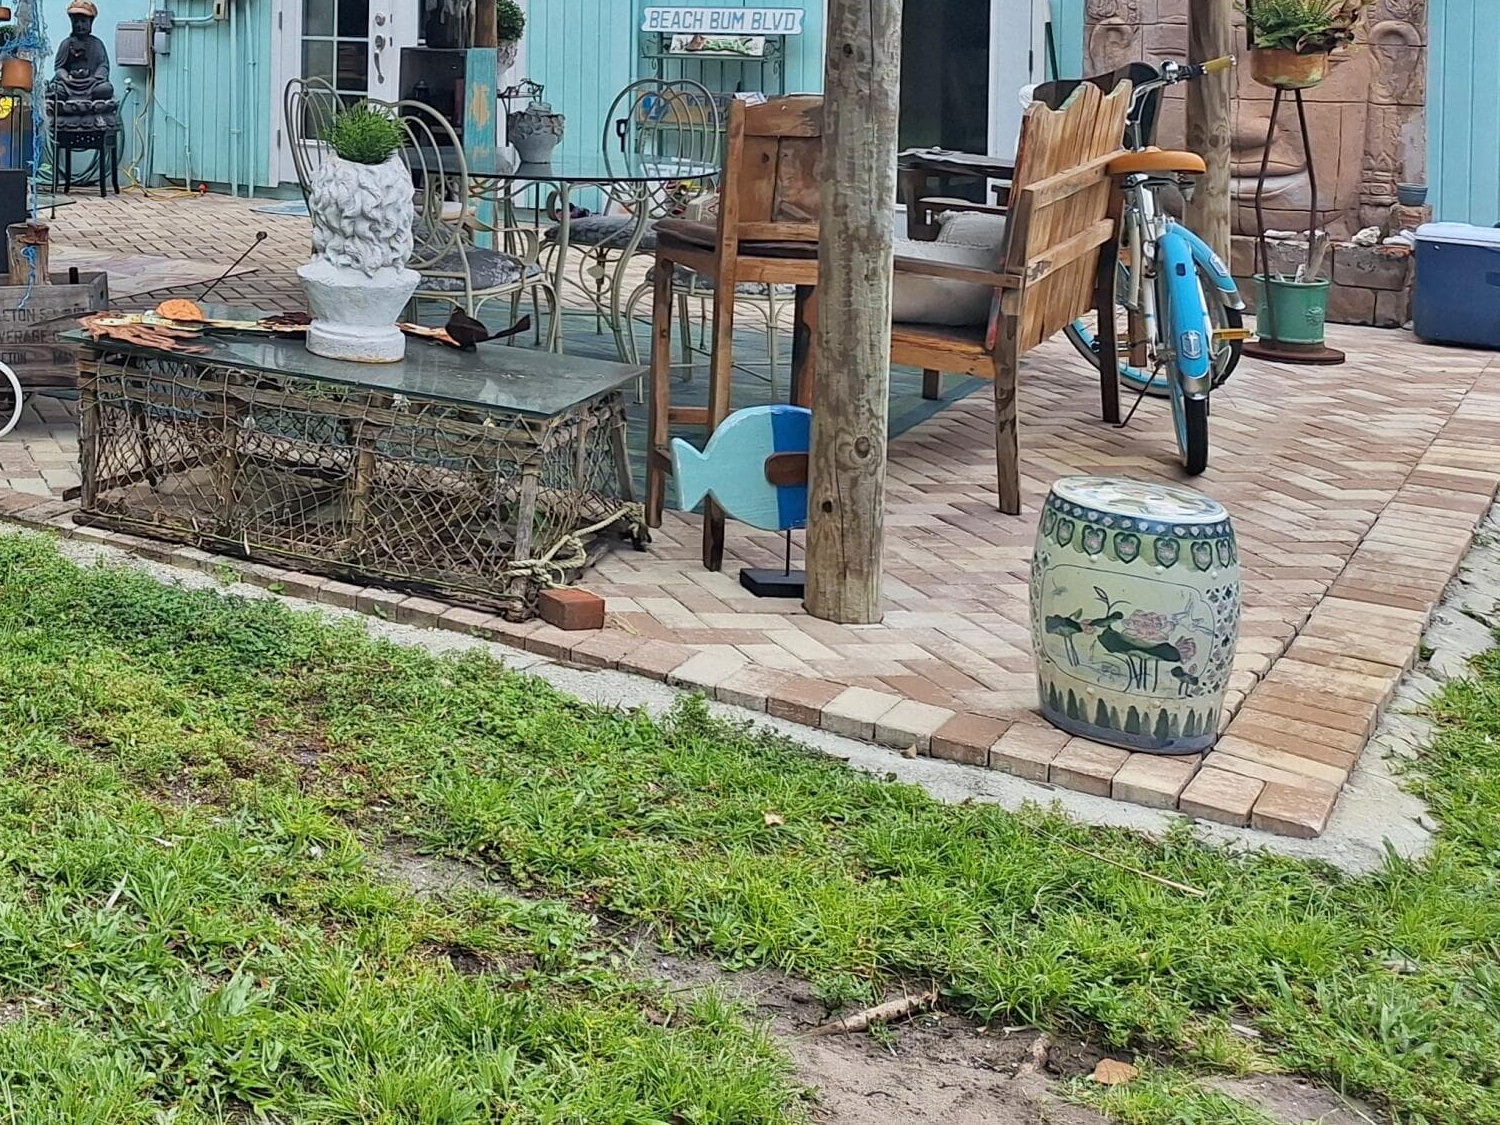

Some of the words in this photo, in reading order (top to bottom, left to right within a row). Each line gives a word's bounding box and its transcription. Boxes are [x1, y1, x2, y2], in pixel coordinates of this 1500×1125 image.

[649, 10, 704, 29] BEACH
[709, 11, 745, 30] BUM
[751, 12, 796, 31] BLVD
